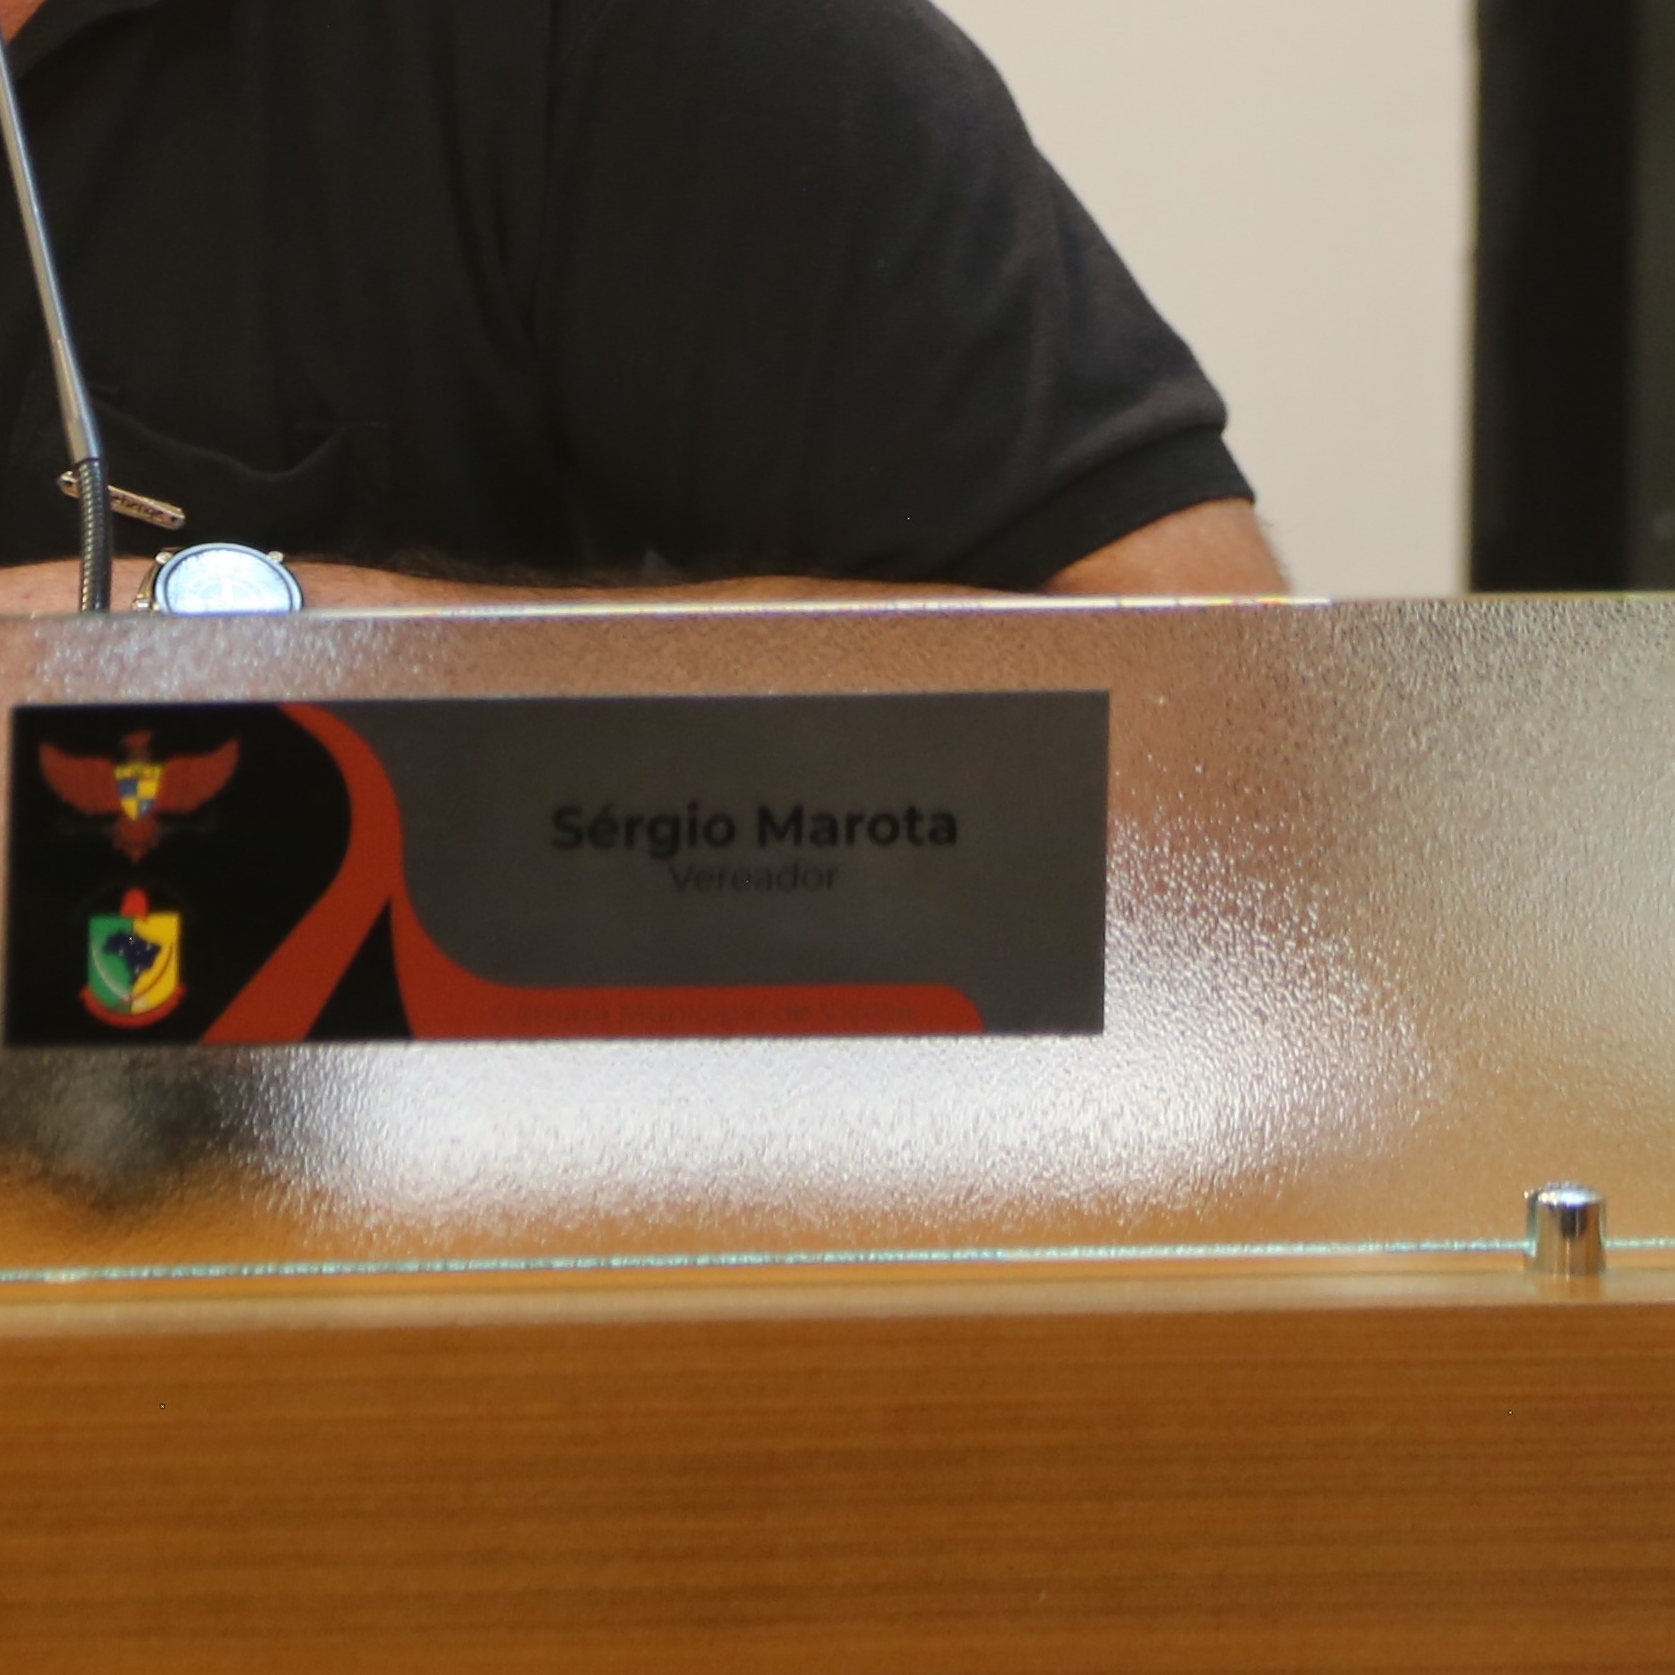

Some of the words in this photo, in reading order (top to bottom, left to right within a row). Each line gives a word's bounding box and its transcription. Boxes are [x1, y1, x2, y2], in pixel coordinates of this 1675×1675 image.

[552, 800, 736, 859] Sérgio
[757, 803, 959, 848] Marota
[670, 861, 838, 894] Vereador
